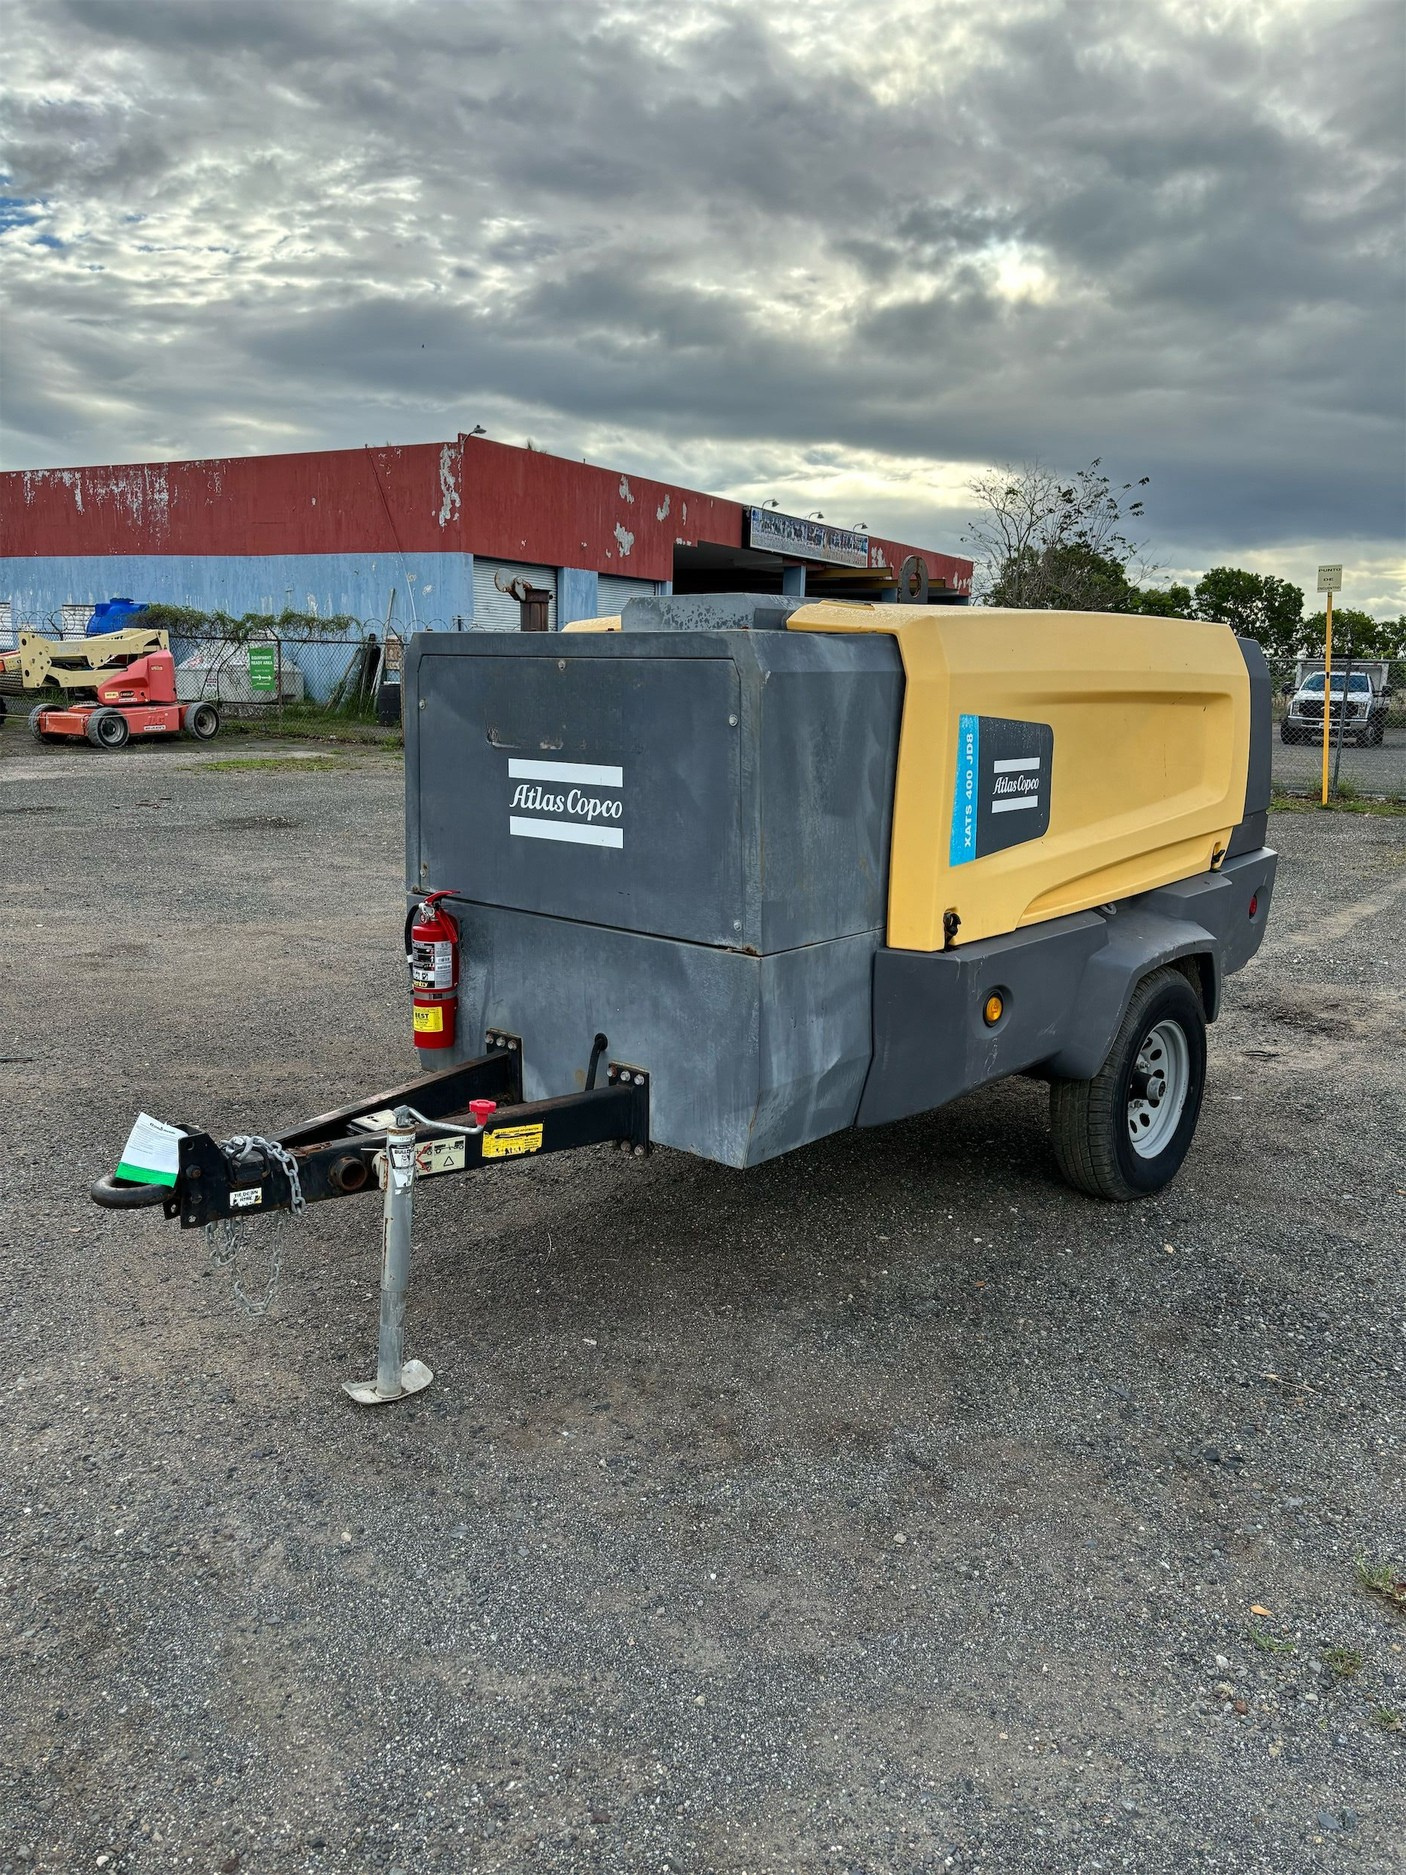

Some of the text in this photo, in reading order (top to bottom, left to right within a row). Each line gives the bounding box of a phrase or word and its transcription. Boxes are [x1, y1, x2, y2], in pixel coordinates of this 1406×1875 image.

[965, 770, 973, 800] 400
[992, 774, 1040, 795] Atlas Copco
[509, 784, 623, 821] Atlas Copco
[964, 804, 973, 847] XATS
